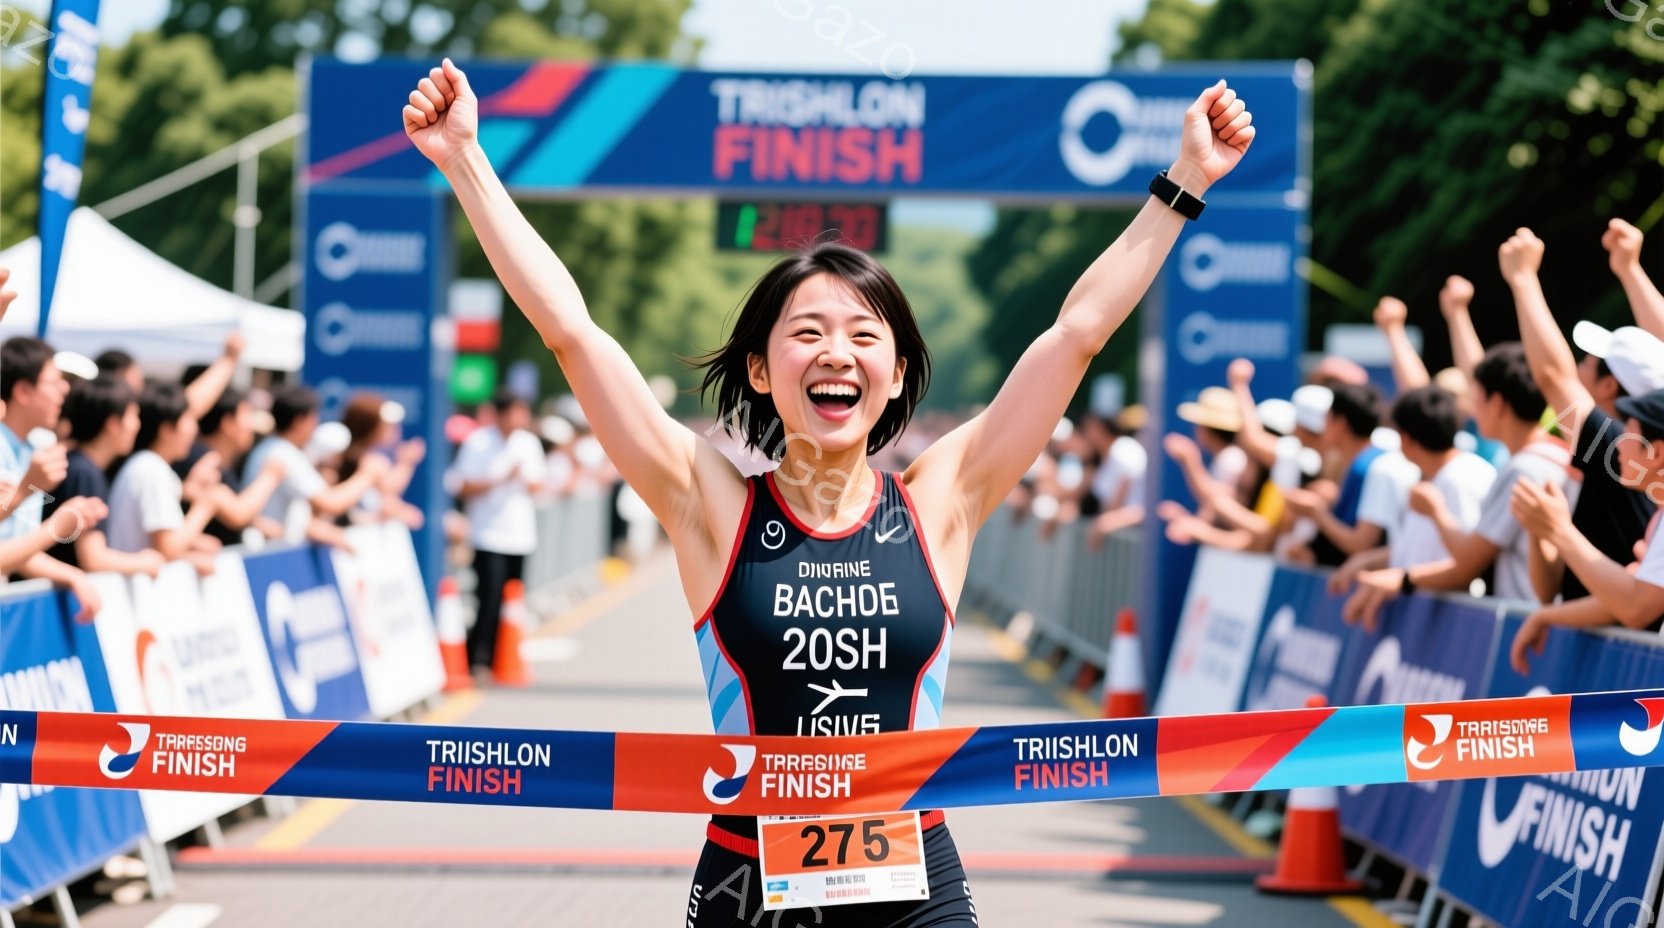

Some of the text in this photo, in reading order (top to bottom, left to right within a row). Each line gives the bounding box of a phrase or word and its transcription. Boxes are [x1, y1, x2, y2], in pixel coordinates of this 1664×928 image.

[712, 123, 923, 184] FINISH
[426, 740, 551, 767] TRIISHLON
[1013, 733, 1138, 760] TRIISHLON
[1456, 736, 1535, 761] FINISH
[152, 751, 235, 777] FINISH
[1014, 761, 1108, 790] FINISH
[427, 766, 521, 794] FINISH
[761, 773, 851, 798] FINISH
[800, 820, 890, 868] 275
[1518, 783, 1632, 882] FINISH
